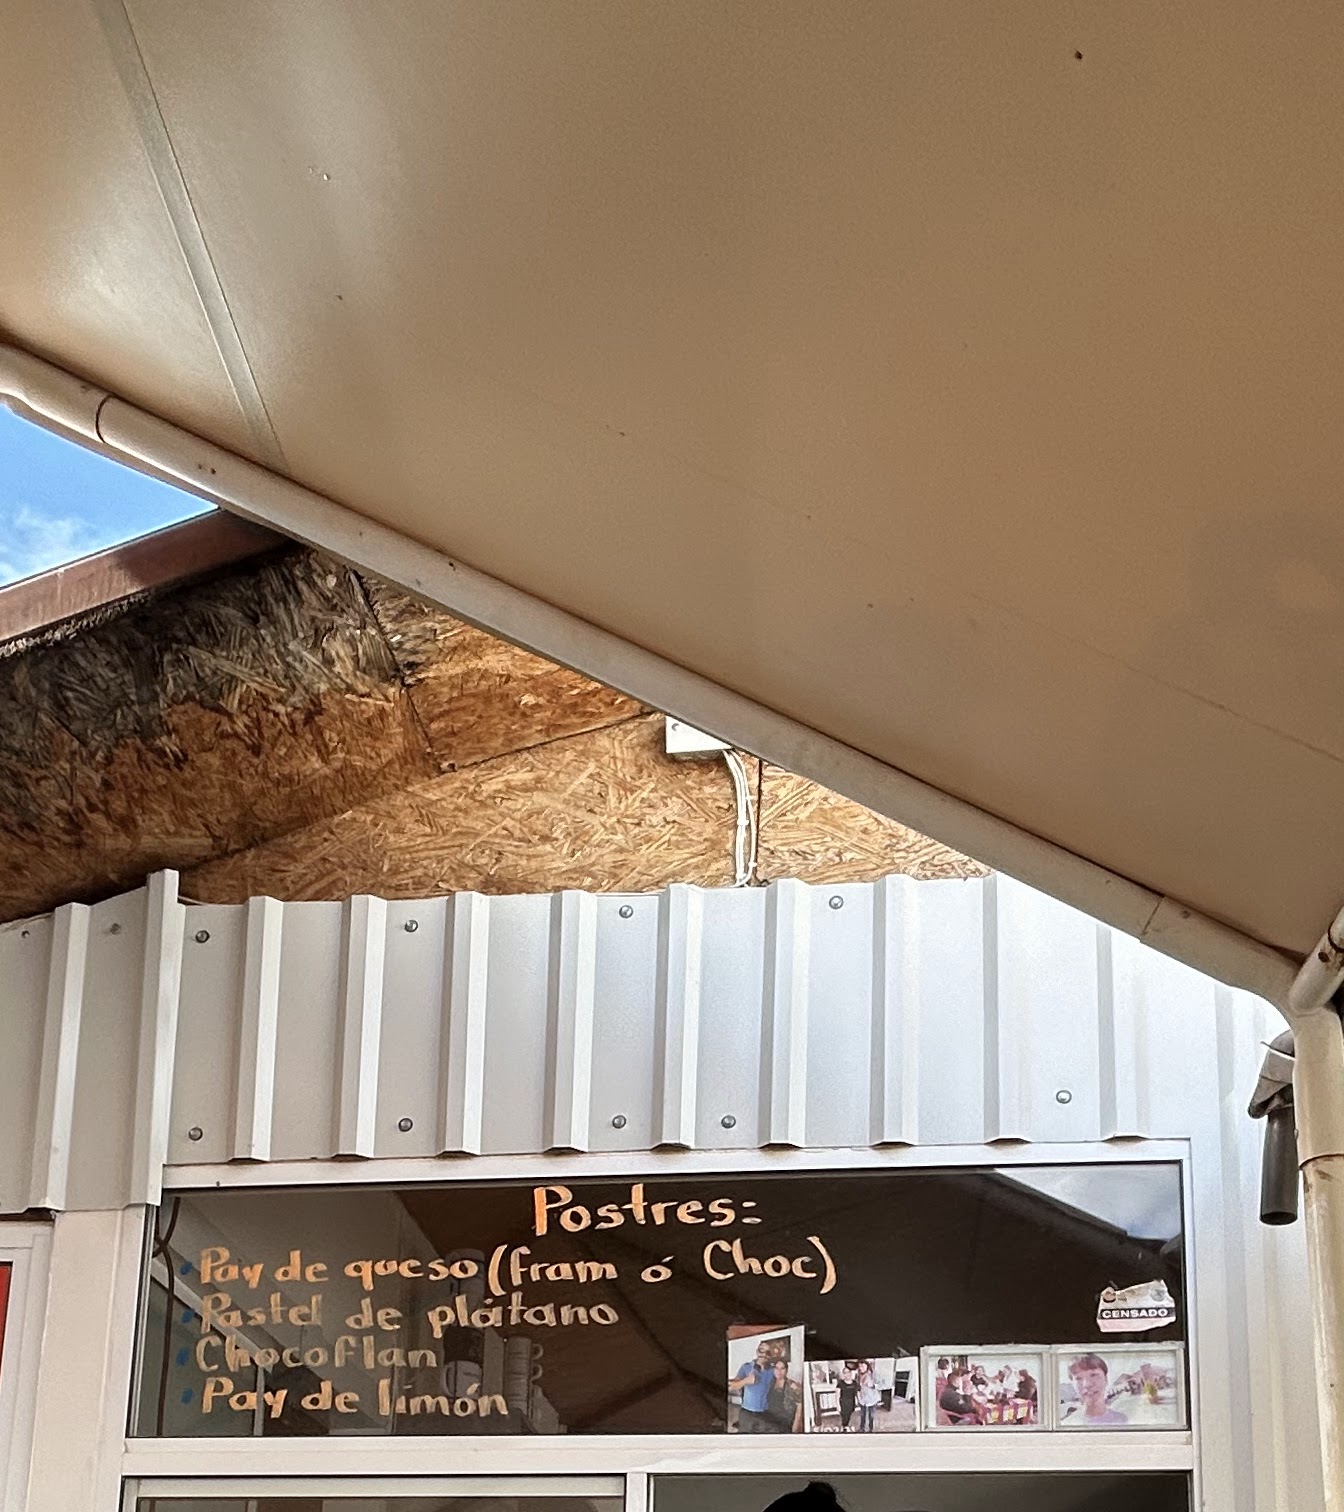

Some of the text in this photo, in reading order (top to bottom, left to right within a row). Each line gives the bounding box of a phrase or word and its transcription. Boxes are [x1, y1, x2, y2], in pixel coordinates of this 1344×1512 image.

[532, 1183, 762, 1236] Postres:
[200, 1247, 264, 1288] Pay
[275, 1250, 329, 1282] de
[345, 1257, 478, 1291] queso
[704, 1235, 838, 1295] Choc)
[200, 1290, 619, 1339] Pastel de plátano
[1102, 1308, 1168, 1318] CENSADO
[202, 1376, 508, 1419] Pay de limón
